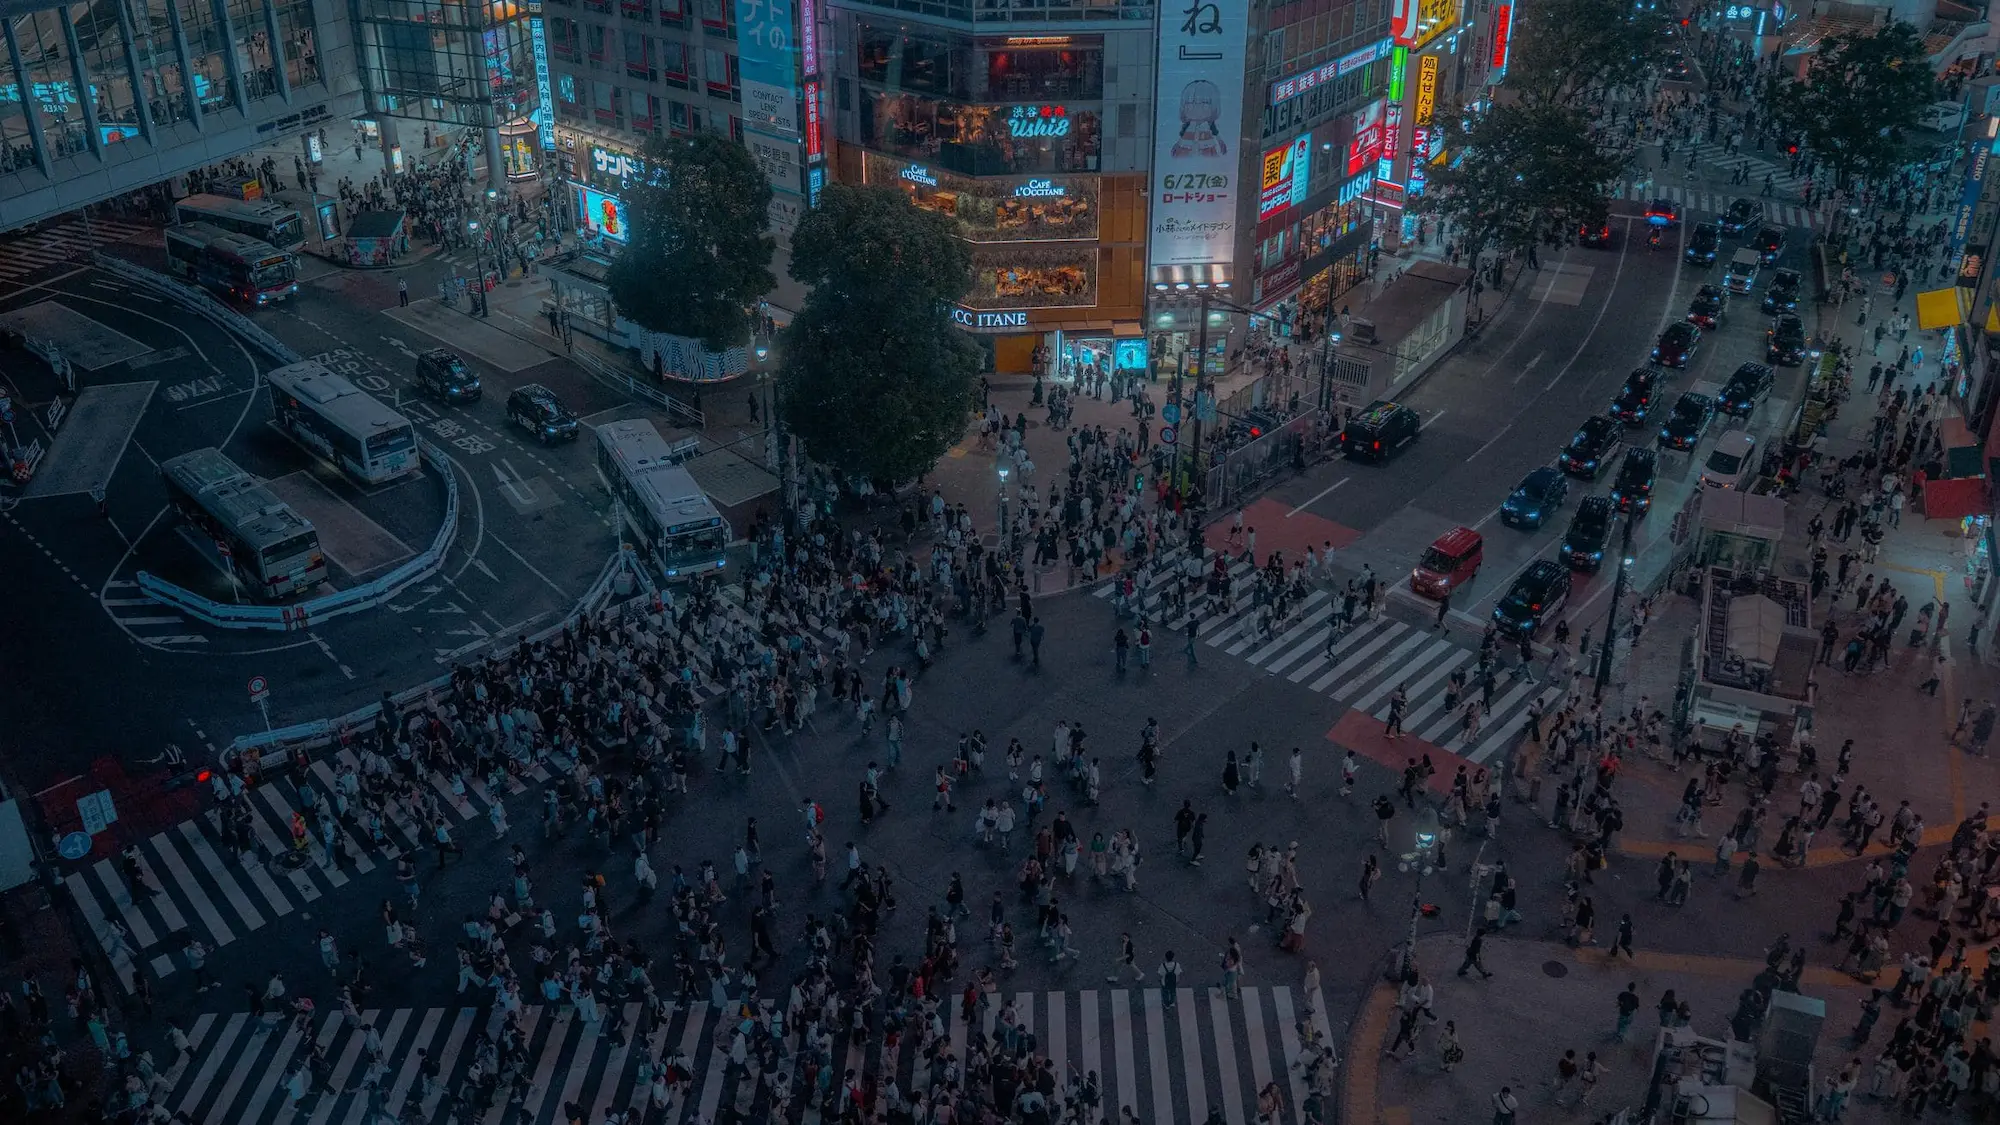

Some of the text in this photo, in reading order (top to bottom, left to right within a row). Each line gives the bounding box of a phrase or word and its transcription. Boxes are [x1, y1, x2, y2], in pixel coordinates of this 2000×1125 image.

[1379, 40, 1392, 58] 4F
[752, 90, 784, 105] CONTACT
[761, 103, 777, 114] LENS
[748, 109, 791, 127] SPECIISTS
[1008, 117, 1069, 137] Ushi8
[1973, 147, 1988, 181] MIZUHO
[902, 170, 937, 186] L'OCCITANE
[1164, 174, 1228, 190] 6/27(金)
[1016, 187, 1064, 197] L'OCCITANE
[1339, 171, 1372, 206] LUSH
[1163, 192, 1227, 204] ロードショー
